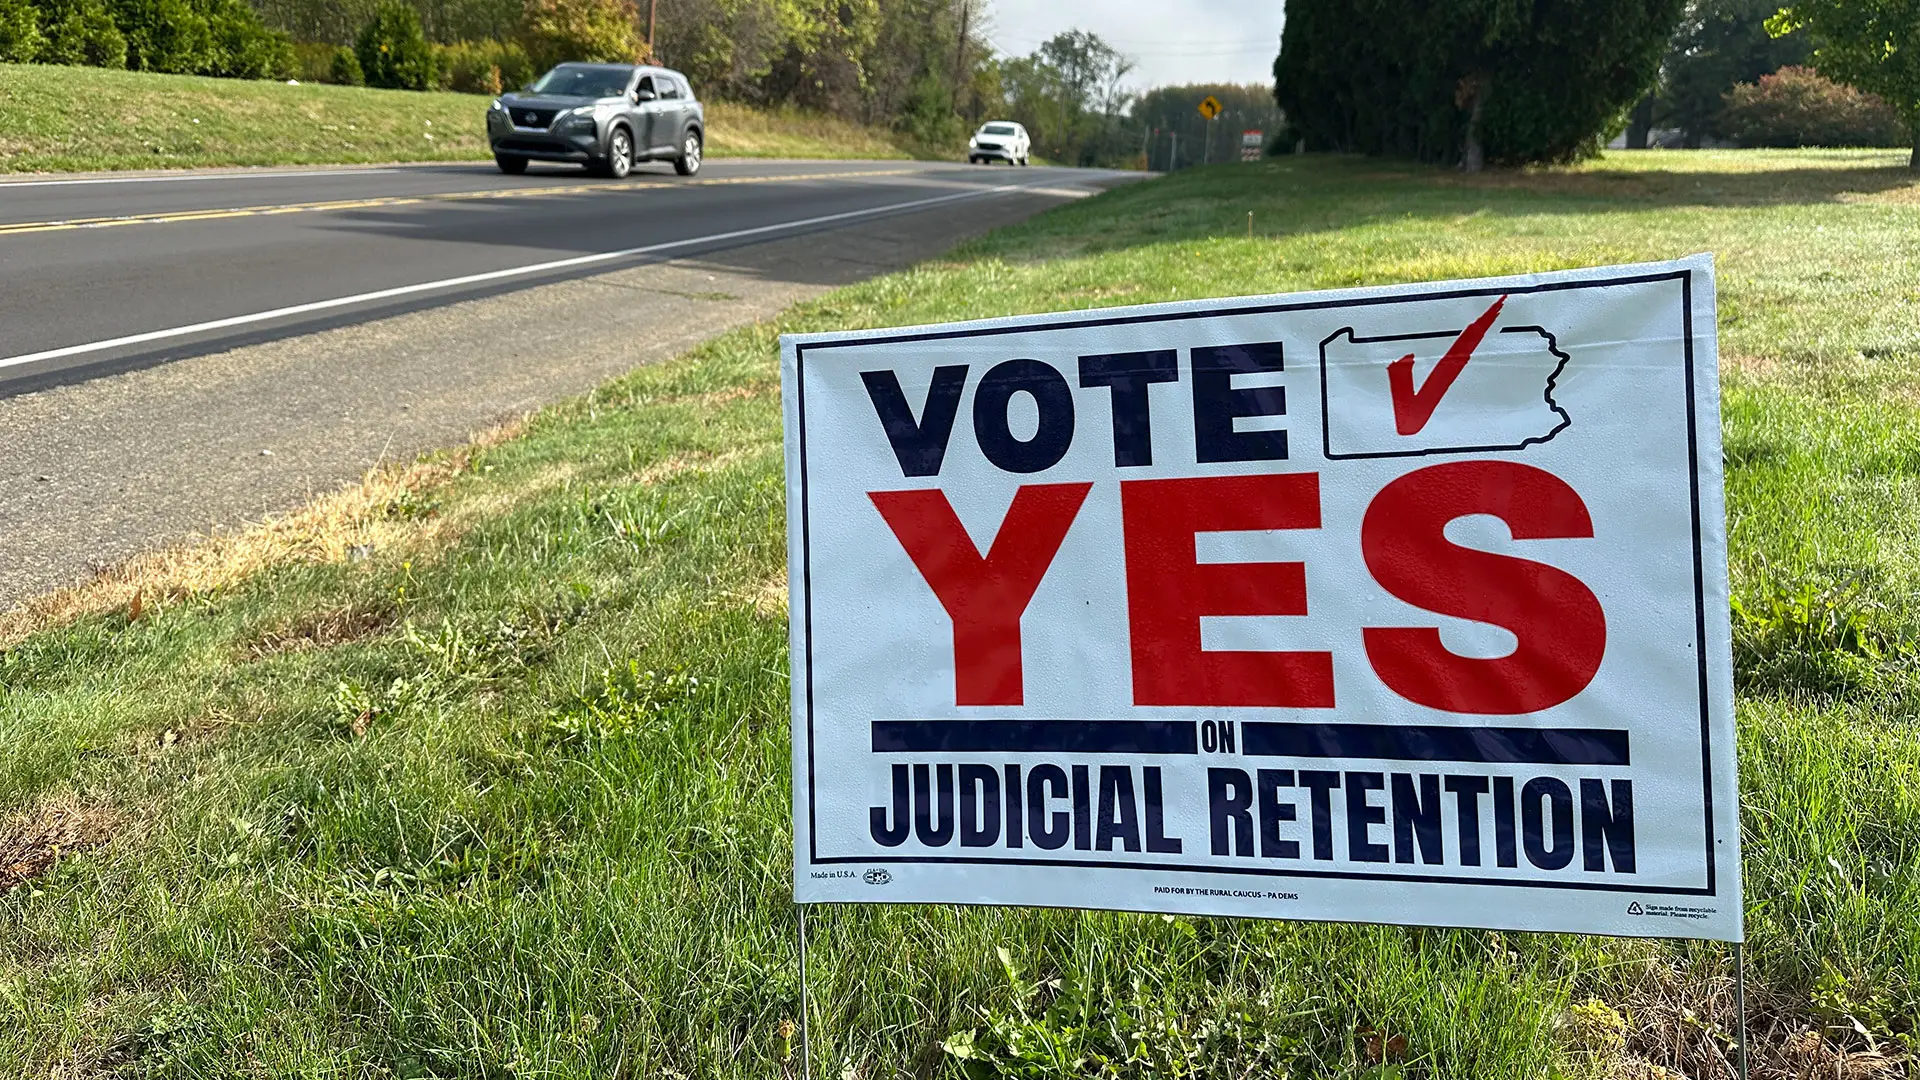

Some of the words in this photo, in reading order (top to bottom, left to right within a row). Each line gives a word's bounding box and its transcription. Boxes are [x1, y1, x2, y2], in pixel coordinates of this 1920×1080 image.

[858, 341, 1289, 478] VOTE
[866, 459, 1608, 716] YES
[1201, 719, 1236, 754] ON
[869, 763, 1183, 854] JUDICIAL
[1207, 767, 1637, 874] RETENTION
[810, 871, 828, 879] Made
[829, 870, 836, 878] in
[836, 870, 858, 878] U.S.A.
[1154, 886, 1170, 894] PAID
[1171, 887, 1185, 895] FOR
[1195, 888, 1209, 896] THE
[1209, 889, 1232, 897] RURAL
[1232, 890, 1262, 899] CAUCUS
[1278, 892, 1299, 900] DEMS
